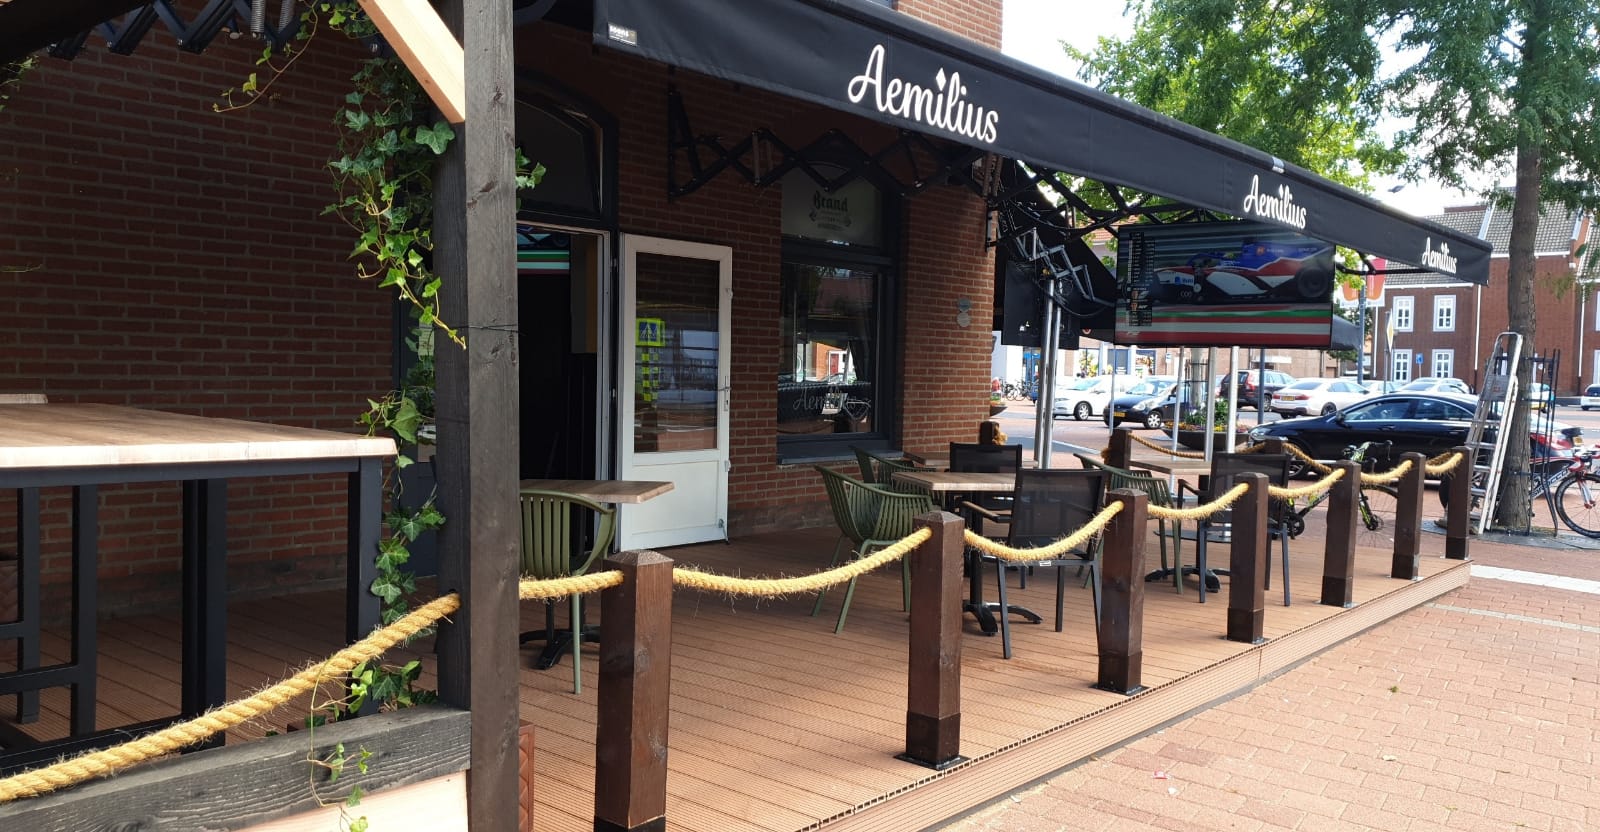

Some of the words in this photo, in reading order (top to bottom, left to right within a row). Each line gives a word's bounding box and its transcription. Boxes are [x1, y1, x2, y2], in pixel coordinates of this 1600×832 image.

[847, 44, 999, 143] Aemilius
[813, 190, 848, 211] Brand
[1243, 174, 1307, 230] Aemilius
[1421, 236, 1457, 274] Aemilius
